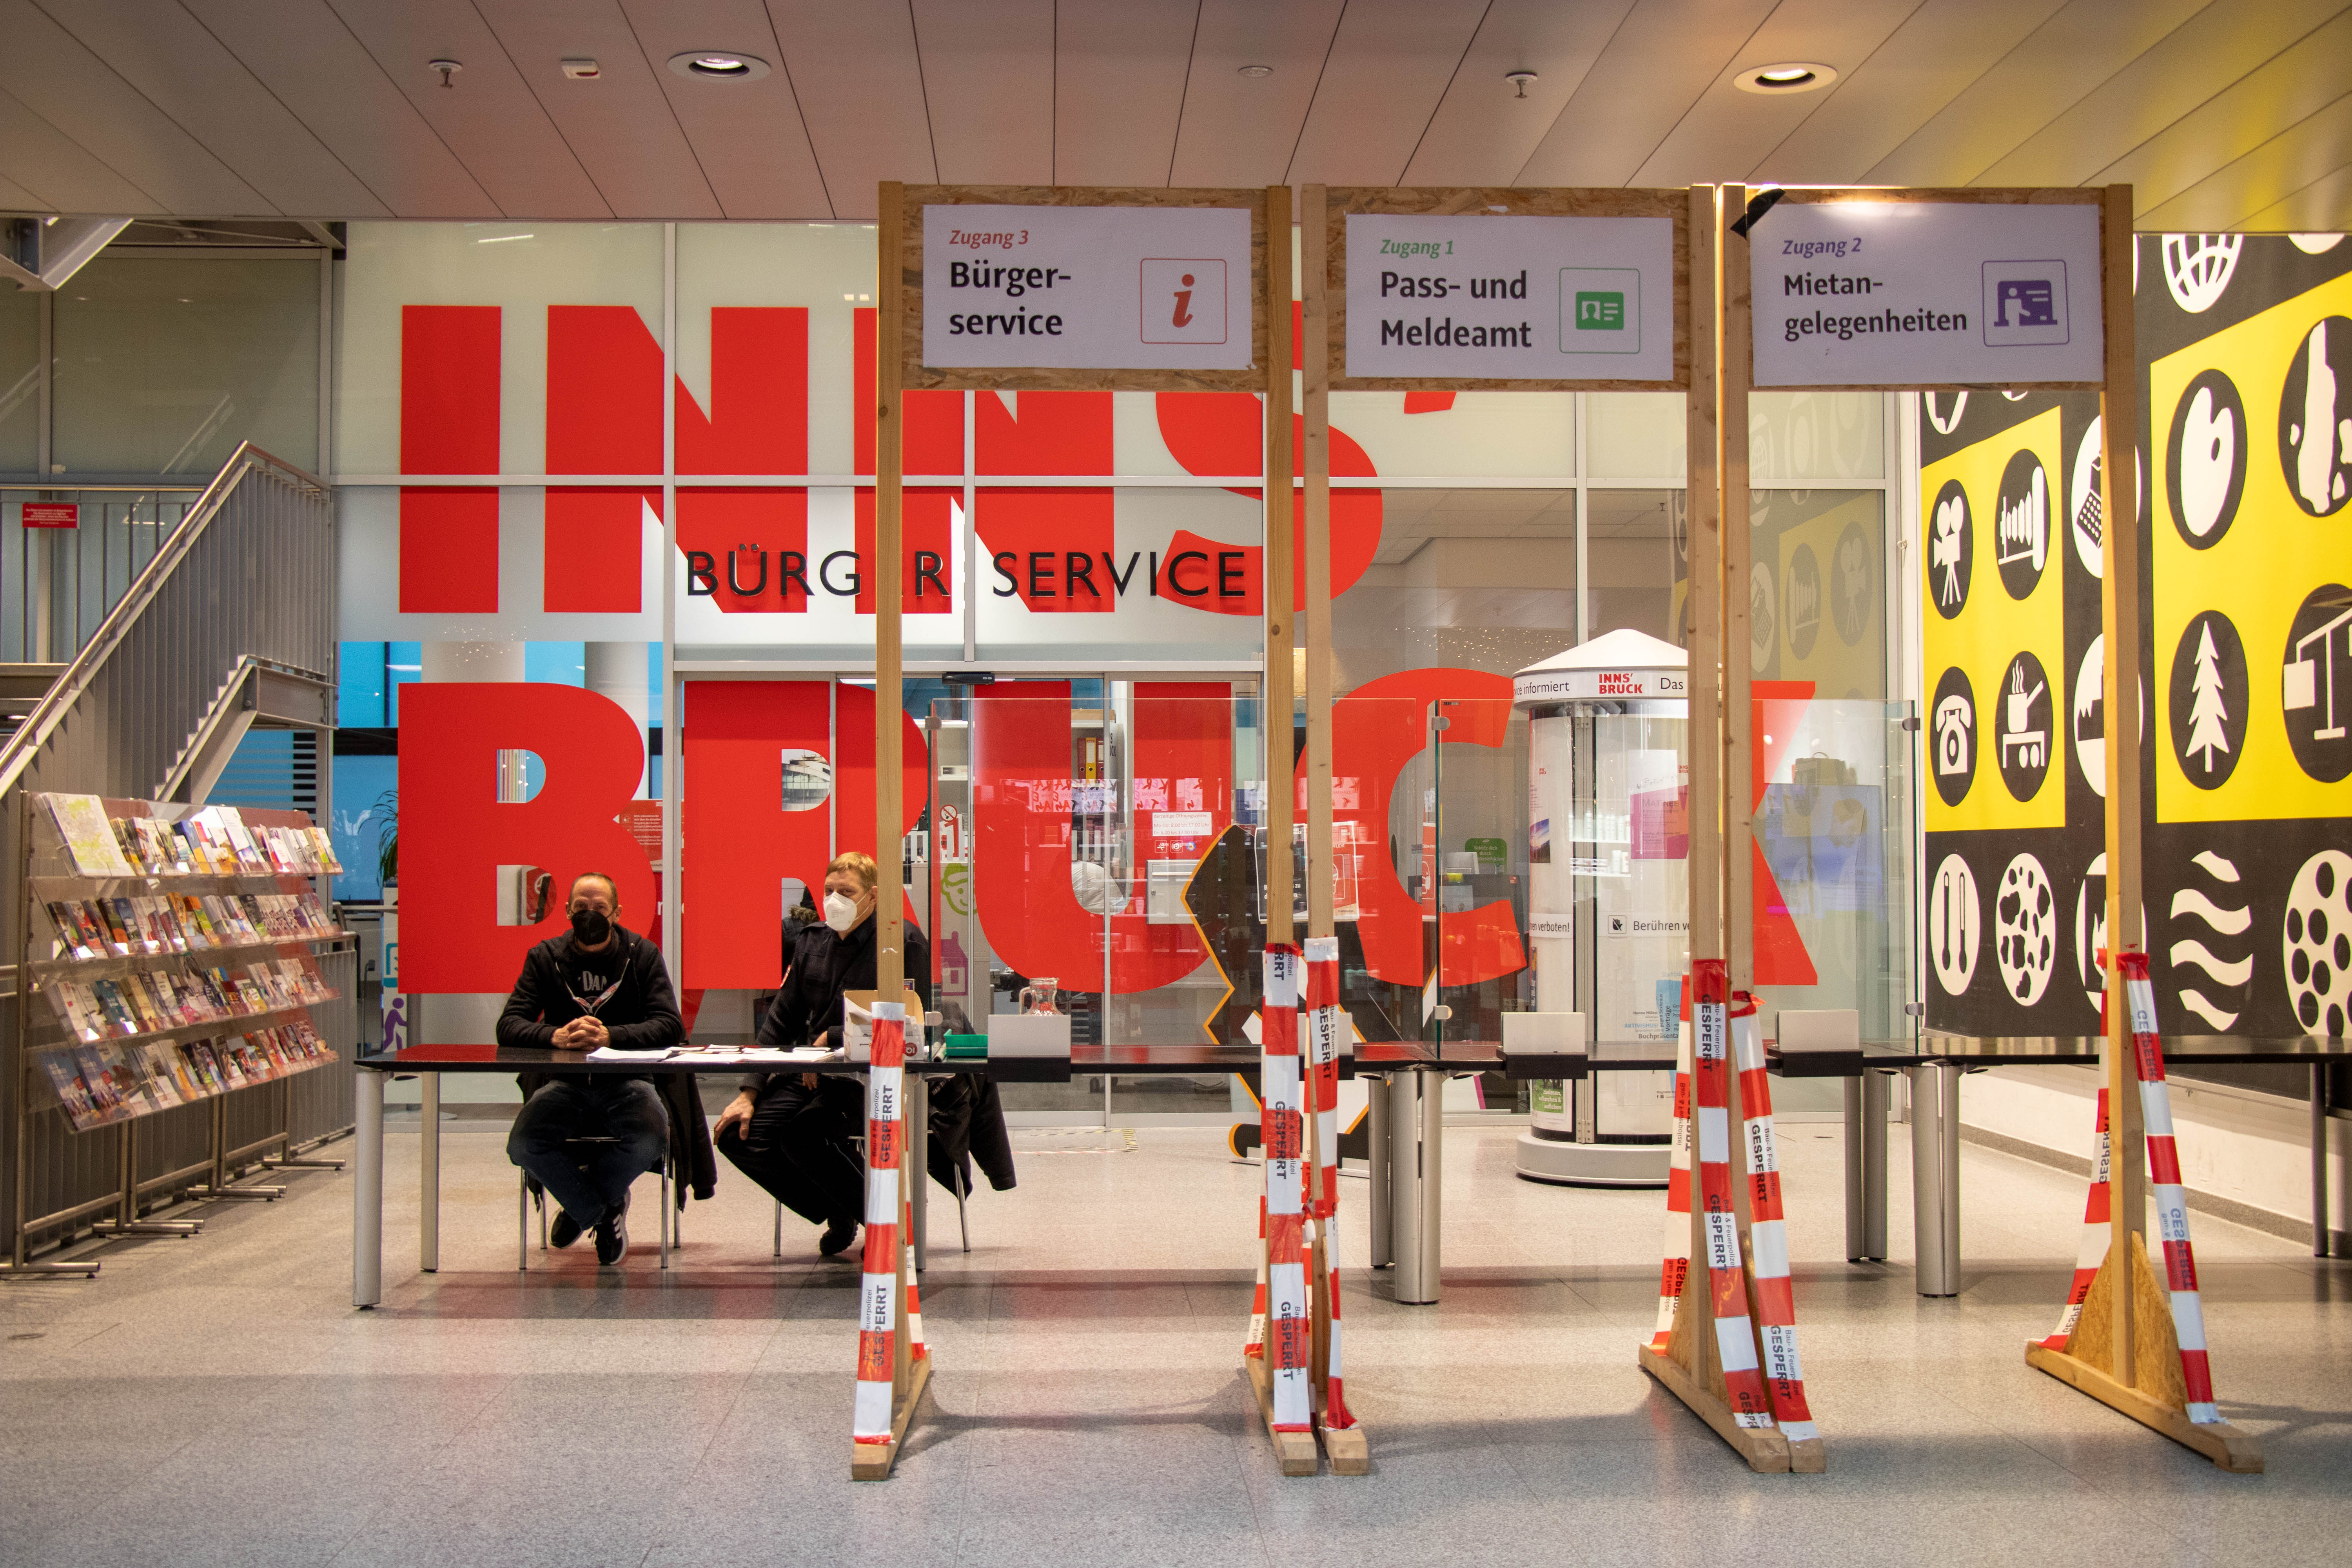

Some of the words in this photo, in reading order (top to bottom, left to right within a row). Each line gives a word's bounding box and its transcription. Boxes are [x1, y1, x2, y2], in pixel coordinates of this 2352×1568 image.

[949, 230, 1014, 249] Zugang
[1018, 230, 1029, 245] 3
[1380, 239, 1441, 258] Zugang
[1445, 240, 1454, 254] 1
[1782, 238, 1847, 258] Zugang
[1851, 238, 1861, 252] 2
[951, 260, 1071, 297] Bürger-
[1381, 271, 1461, 298] Pass-
[1470, 270, 1527, 299] und
[1784, 272, 1883, 296] Mietan-
[950, 306, 1062, 336] service
[1381, 317, 1532, 347] Meldeamt
[1785, 308, 1967, 341] gelegenheiten
[687, 543, 951, 597] BÜRGR
[993, 550, 1246, 598] SERVICE
[1523, 681, 1570, 693] informiert
[1599, 684, 1642, 694] BRUCK
[1661, 678, 1683, 690] Das
[1538, 922, 1570, 932] verboten!
[1633, 920, 1680, 931] Berühren
[1319, 1004, 1332, 1079] GESPERRT
[1701, 994, 1712, 1072] GESPERRT
[880, 1085, 893, 1163] GESPERRT
[1276, 1101, 1287, 1180] GESPERRT
[1752, 1124, 1768, 1202] GESPERRT
[1710, 1194, 1728, 1274] GESPERRT
[873, 1285, 887, 1367] GESPERRT
[1281, 1301, 1294, 1380] GESPERRT
[1770, 1325, 1791, 1400] GESPERRT
